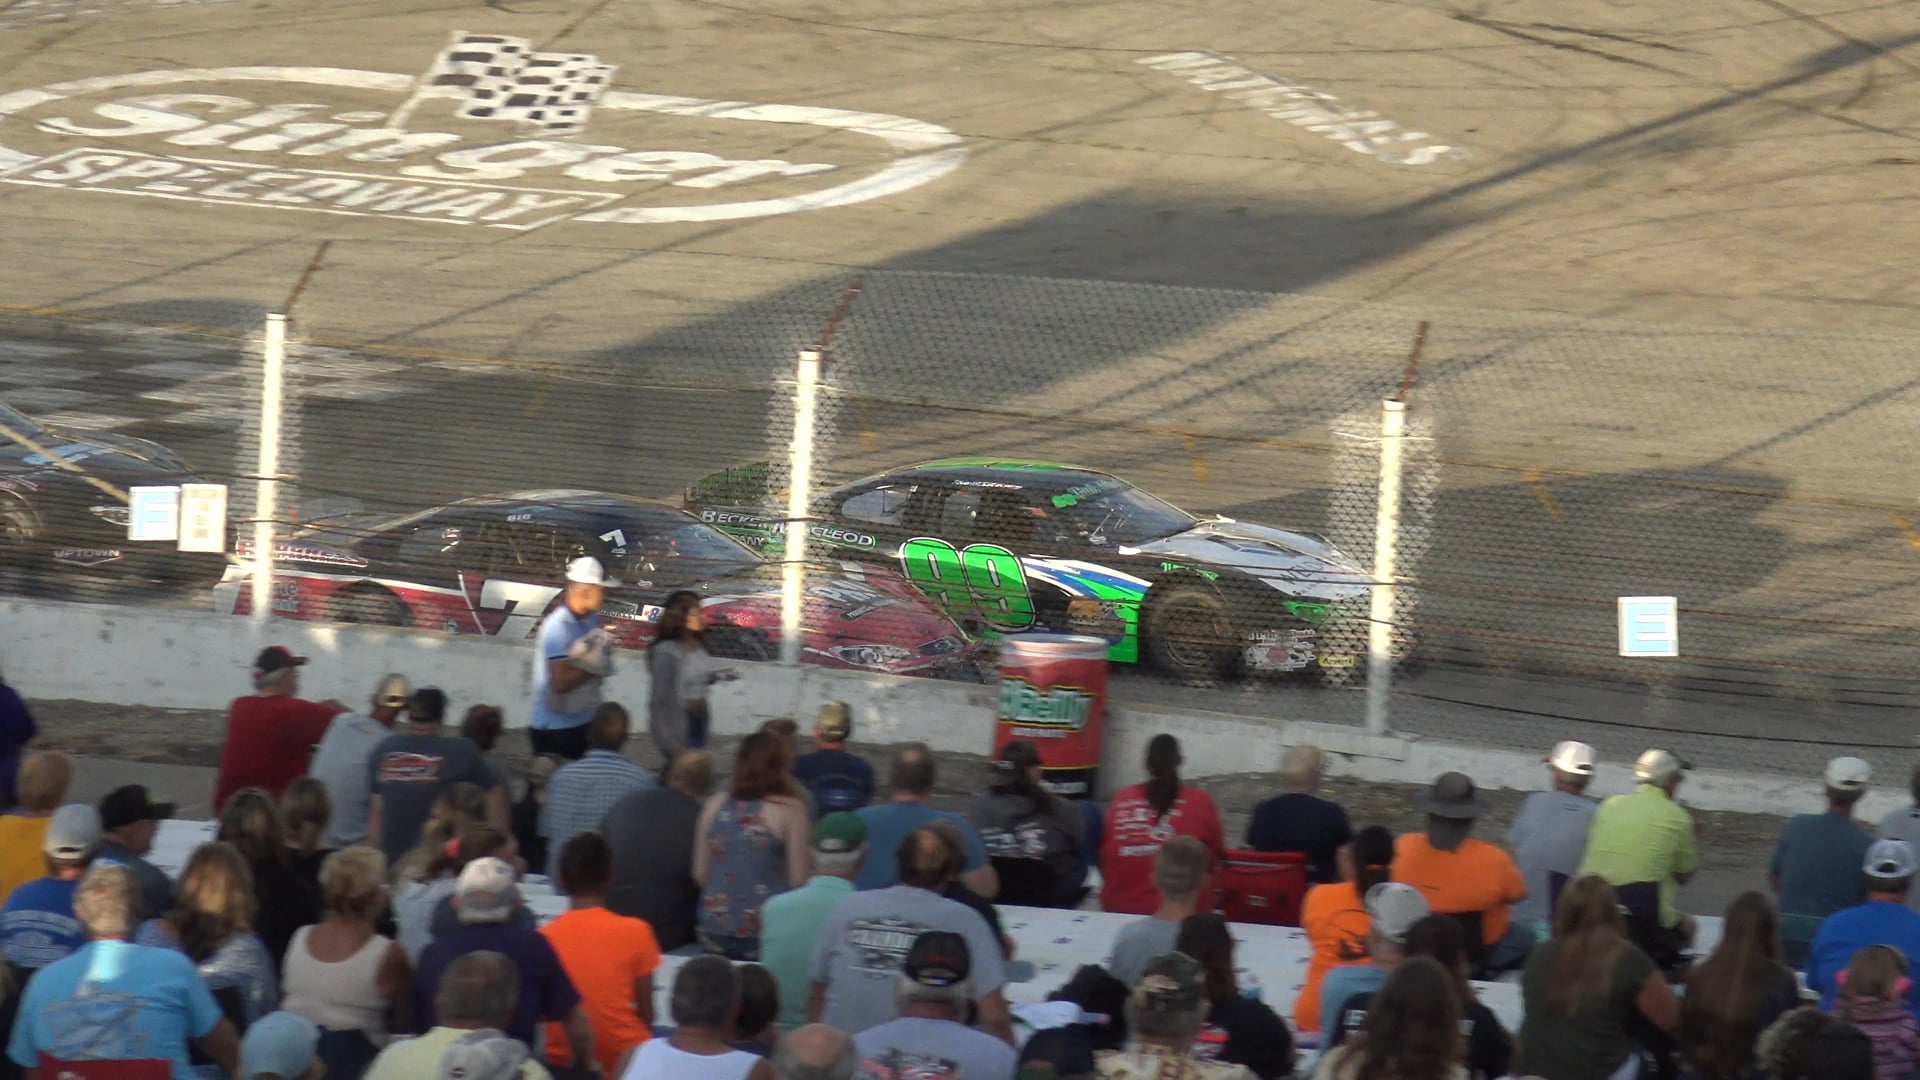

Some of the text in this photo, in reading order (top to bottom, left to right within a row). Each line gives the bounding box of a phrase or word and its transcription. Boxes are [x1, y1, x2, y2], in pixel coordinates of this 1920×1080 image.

[34, 93, 838, 189] Slinger
[29, 154, 591, 221] SPEEDWAY
[479, 578, 564, 640] 7
[1624, 603, 1670, 652] E
